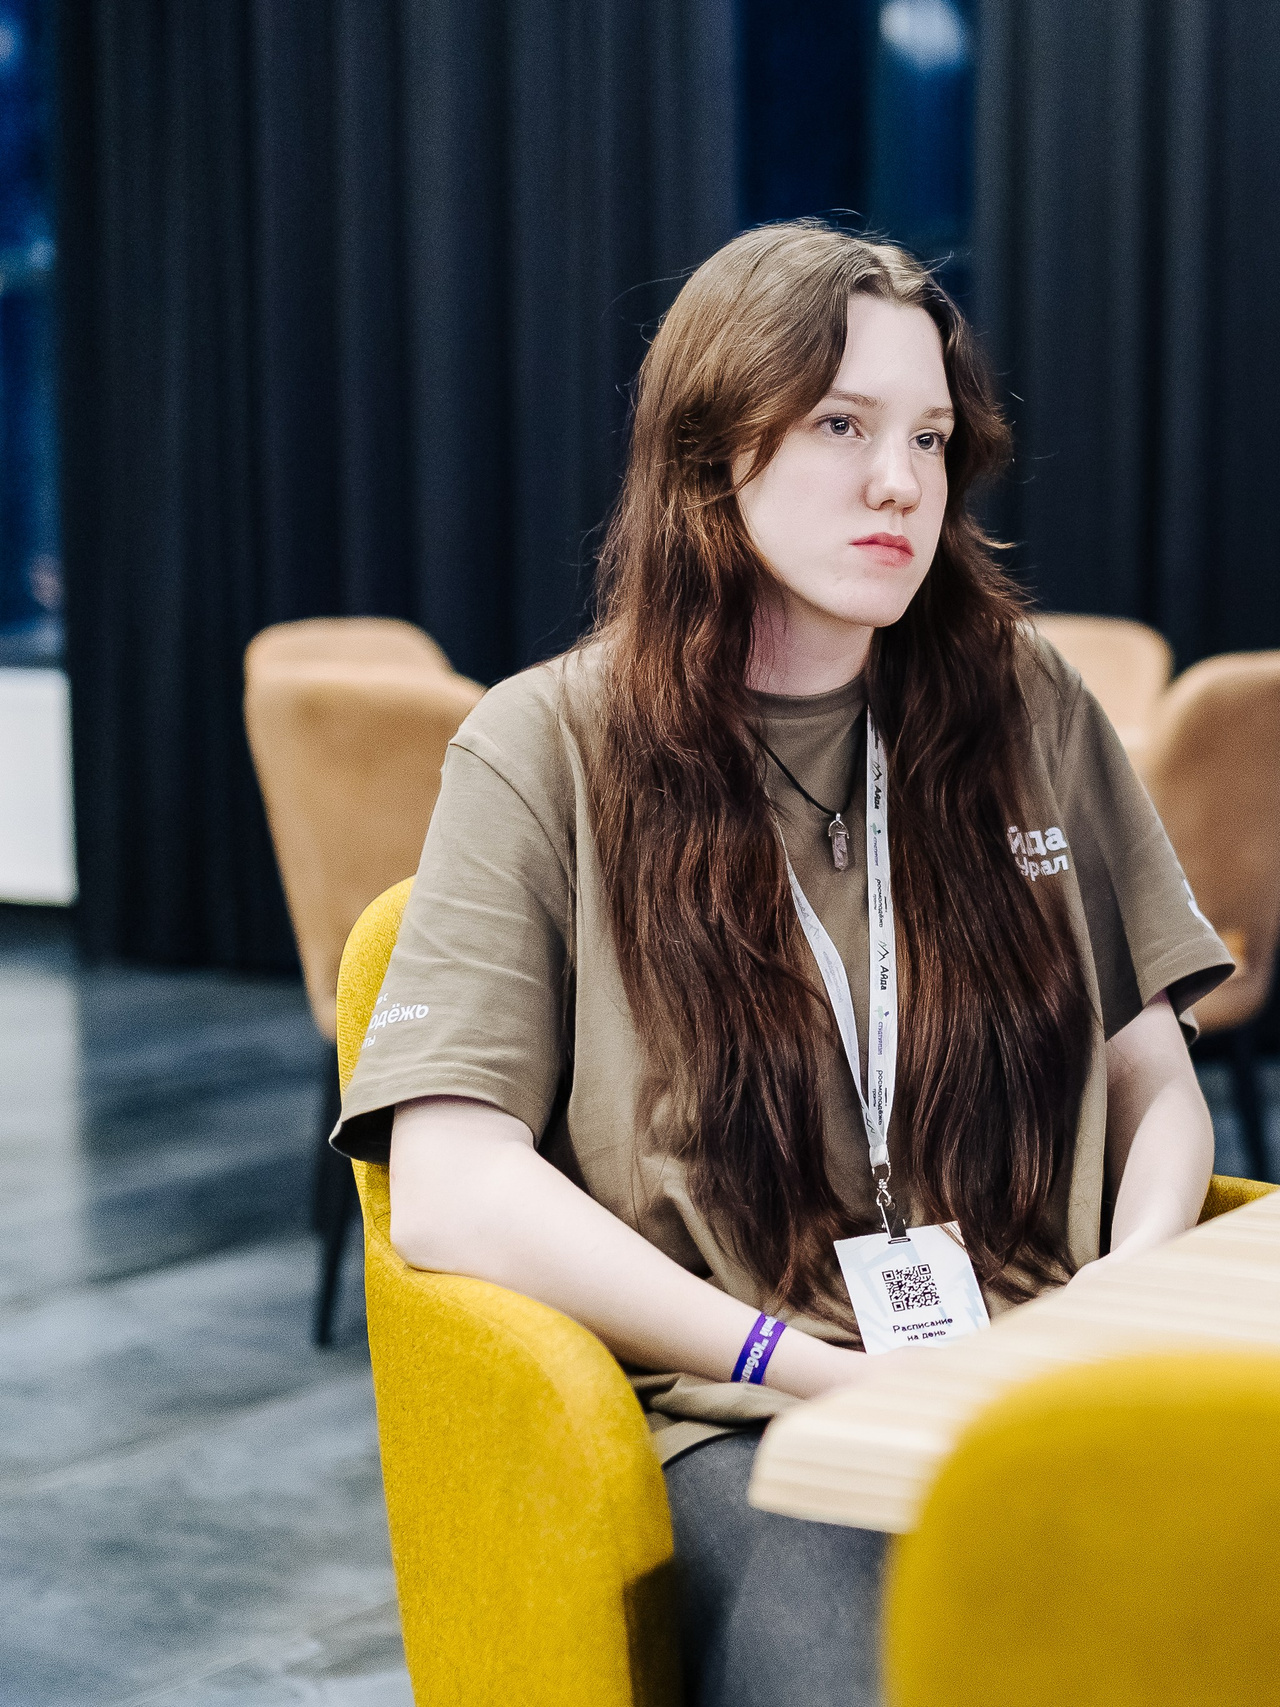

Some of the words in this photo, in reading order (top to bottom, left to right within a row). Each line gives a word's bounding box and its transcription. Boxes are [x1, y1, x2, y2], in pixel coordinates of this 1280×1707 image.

[880, 965, 889, 991] Айда
[892, 1317, 954, 1334] Расписание
[907, 1333, 919, 1342] на
[922, 1330, 947, 1340] день
